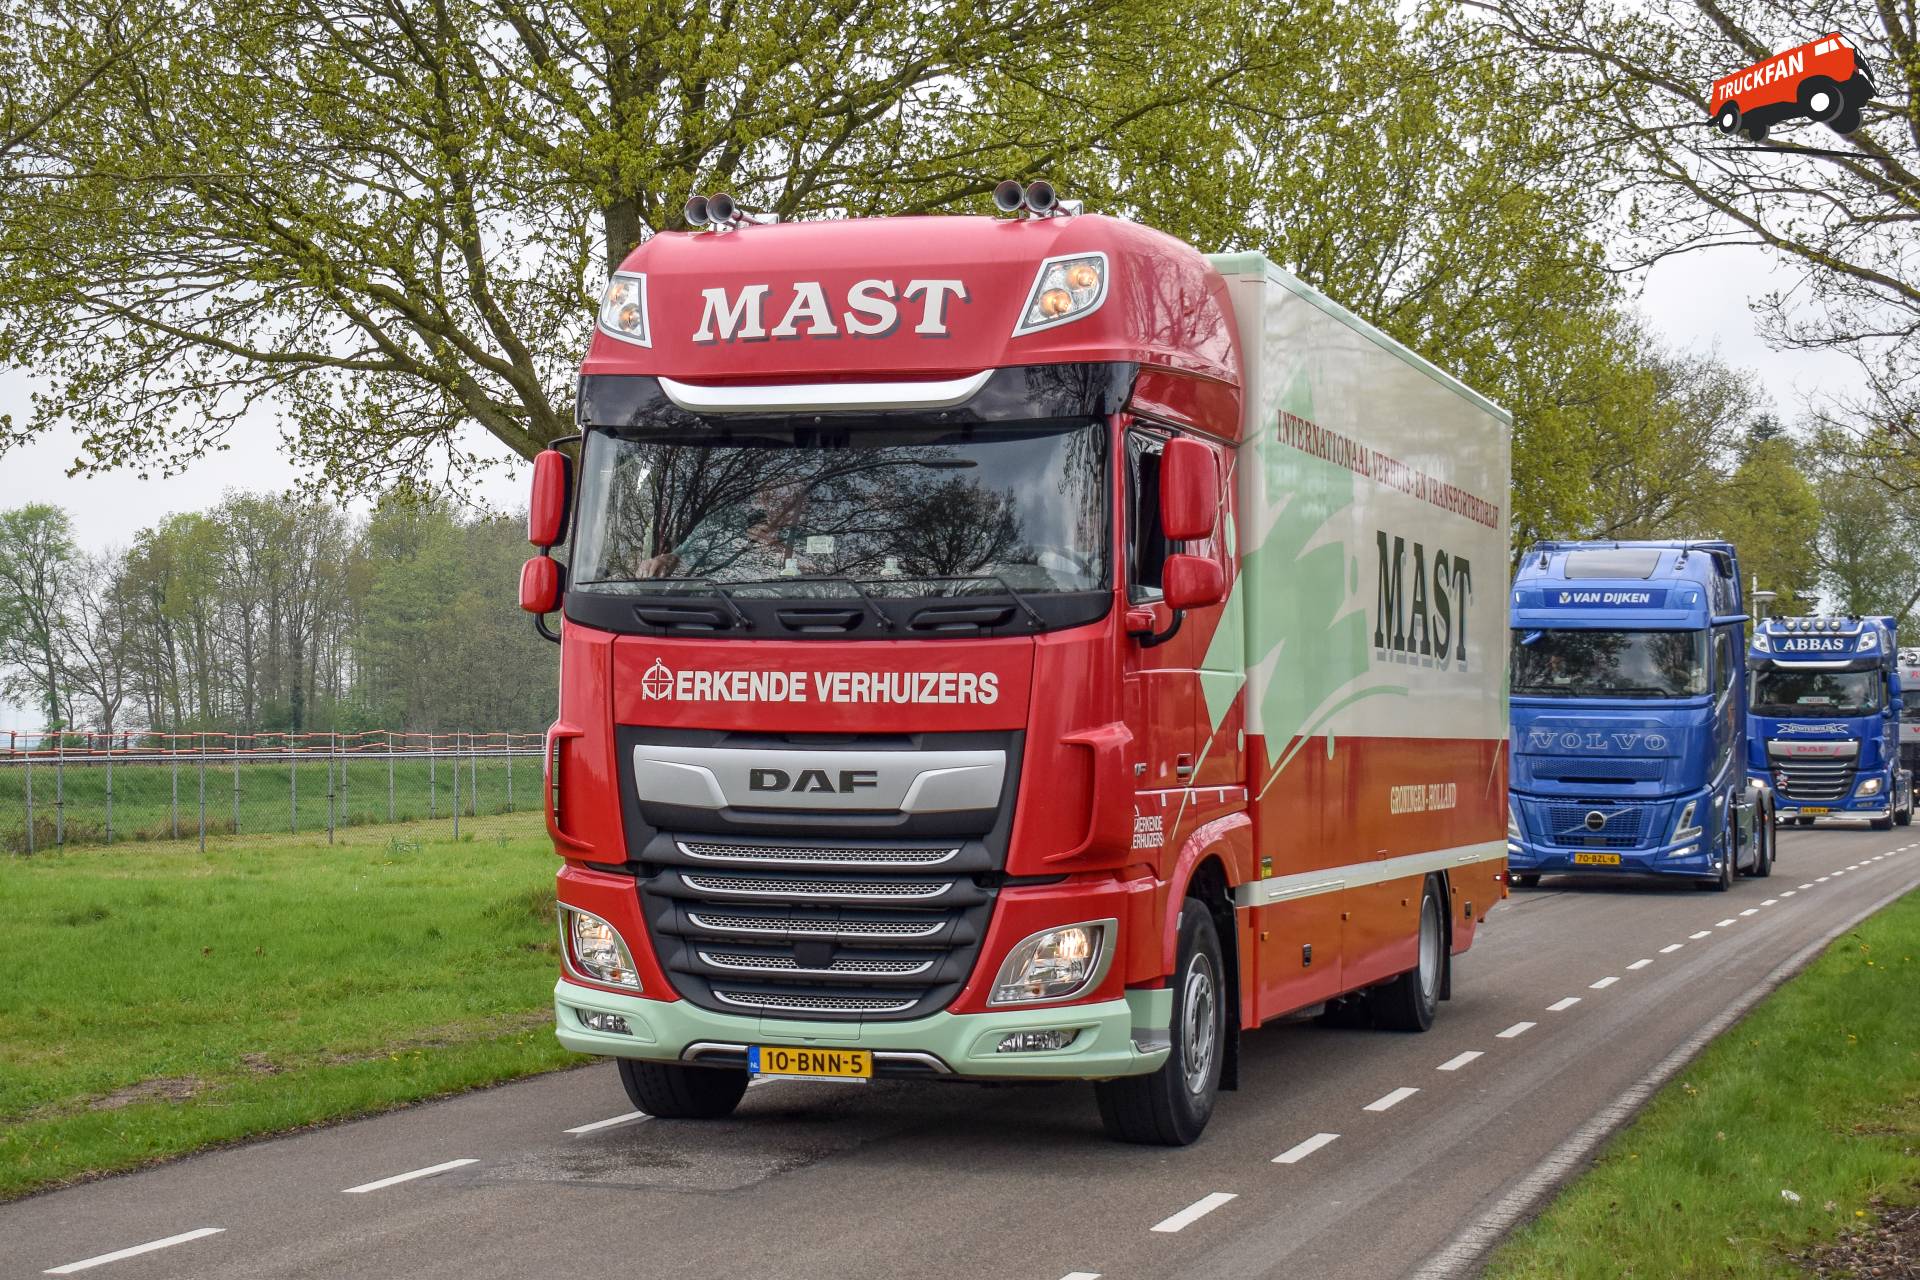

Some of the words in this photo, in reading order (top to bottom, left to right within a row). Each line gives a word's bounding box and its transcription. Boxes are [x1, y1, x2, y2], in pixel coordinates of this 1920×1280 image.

[692, 279, 969, 343] MAST
[1278, 409, 1370, 477] INTERNATIONAAL
[1415, 471, 1426, 501] EN
[1428, 476, 1499, 529] TRANSPORTBEDRIJF
[1374, 530, 1473, 666] MAST
[1573, 592, 1600, 603] VAN
[1603, 592, 1649, 605] DIJKEN
[1784, 638, 1844, 651] ABBAS
[676, 671, 807, 702] ERKENDE
[813, 671, 999, 705] VERHUIZERS
[1529, 732, 1667, 750] VOLVO
[1797, 745, 1828, 753] DAF
[750, 768, 878, 794] DAF
[1132, 832, 1164, 849] ERHUIZERS
[767, 1050, 863, 1074] 10-BNN-5
